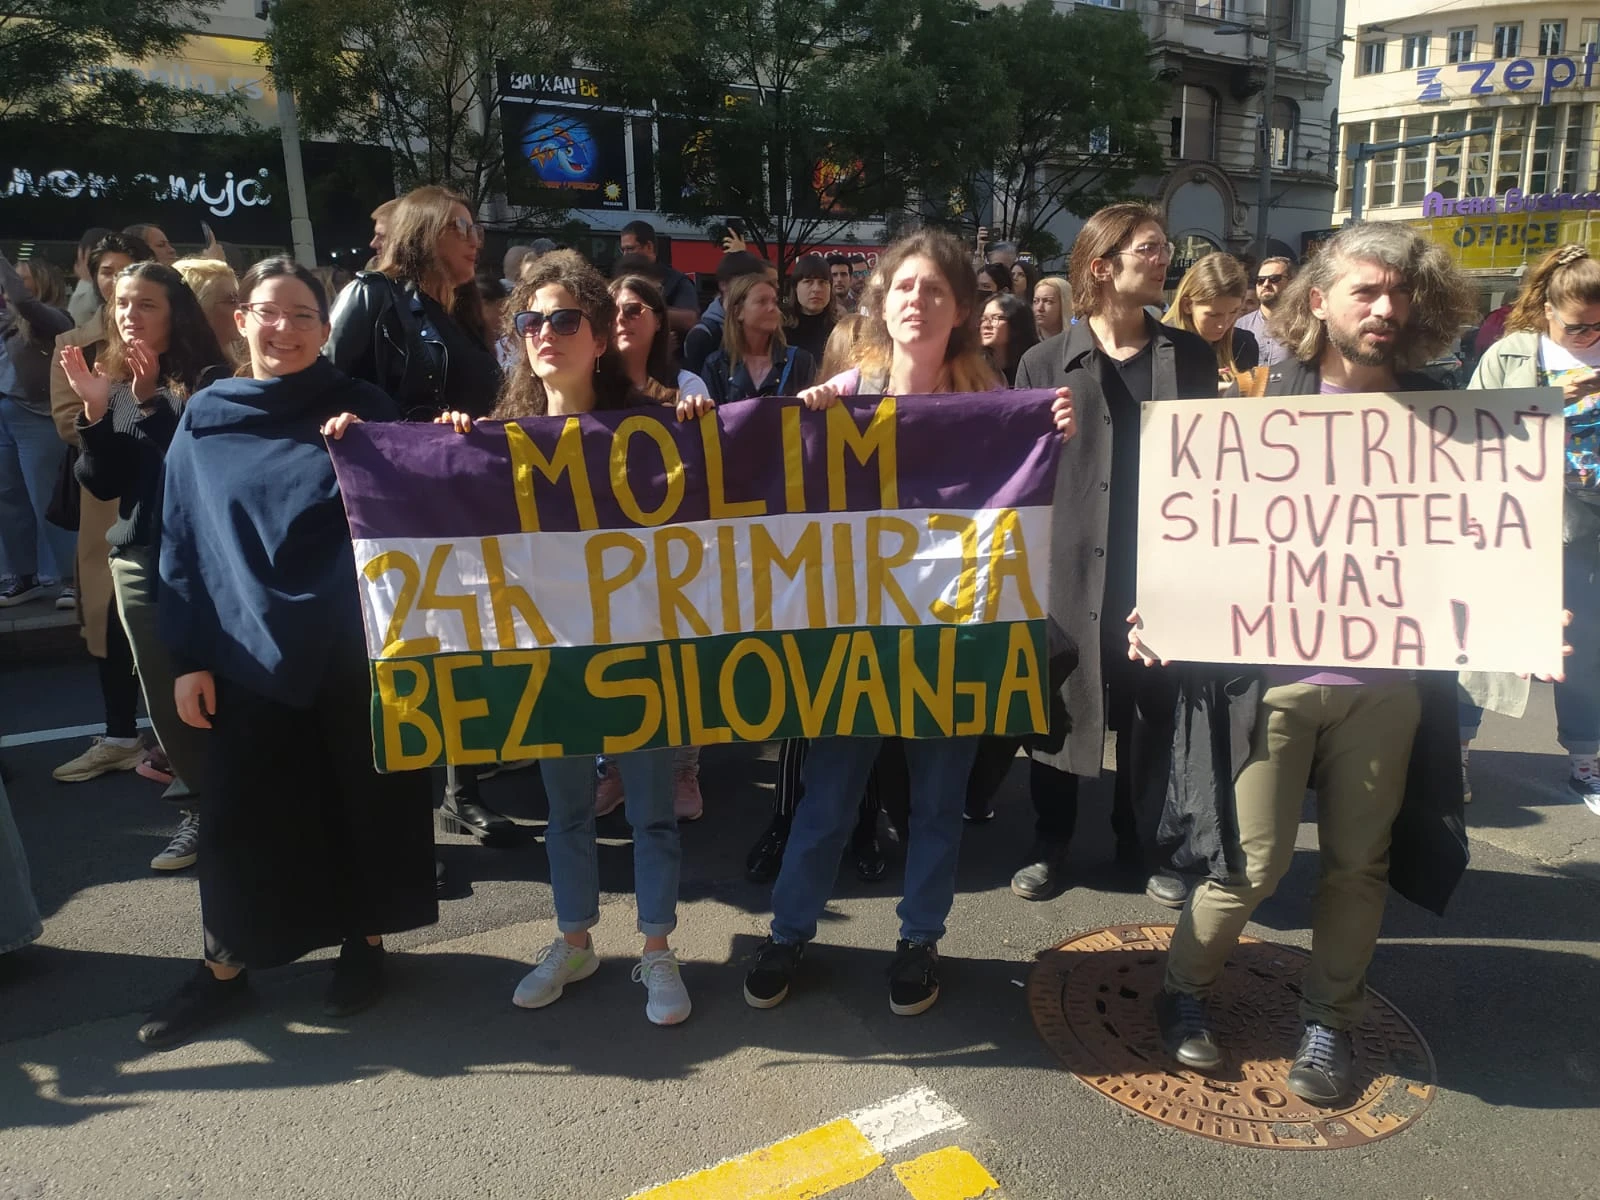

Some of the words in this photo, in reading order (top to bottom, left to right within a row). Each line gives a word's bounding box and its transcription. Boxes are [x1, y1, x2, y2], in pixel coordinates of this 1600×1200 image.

[1453, 222, 1559, 248] OFFICE
[504, 397, 899, 533] MOLIM
[584, 508, 1045, 645] PRIMIRJA
[375, 649, 564, 772] BEZ
